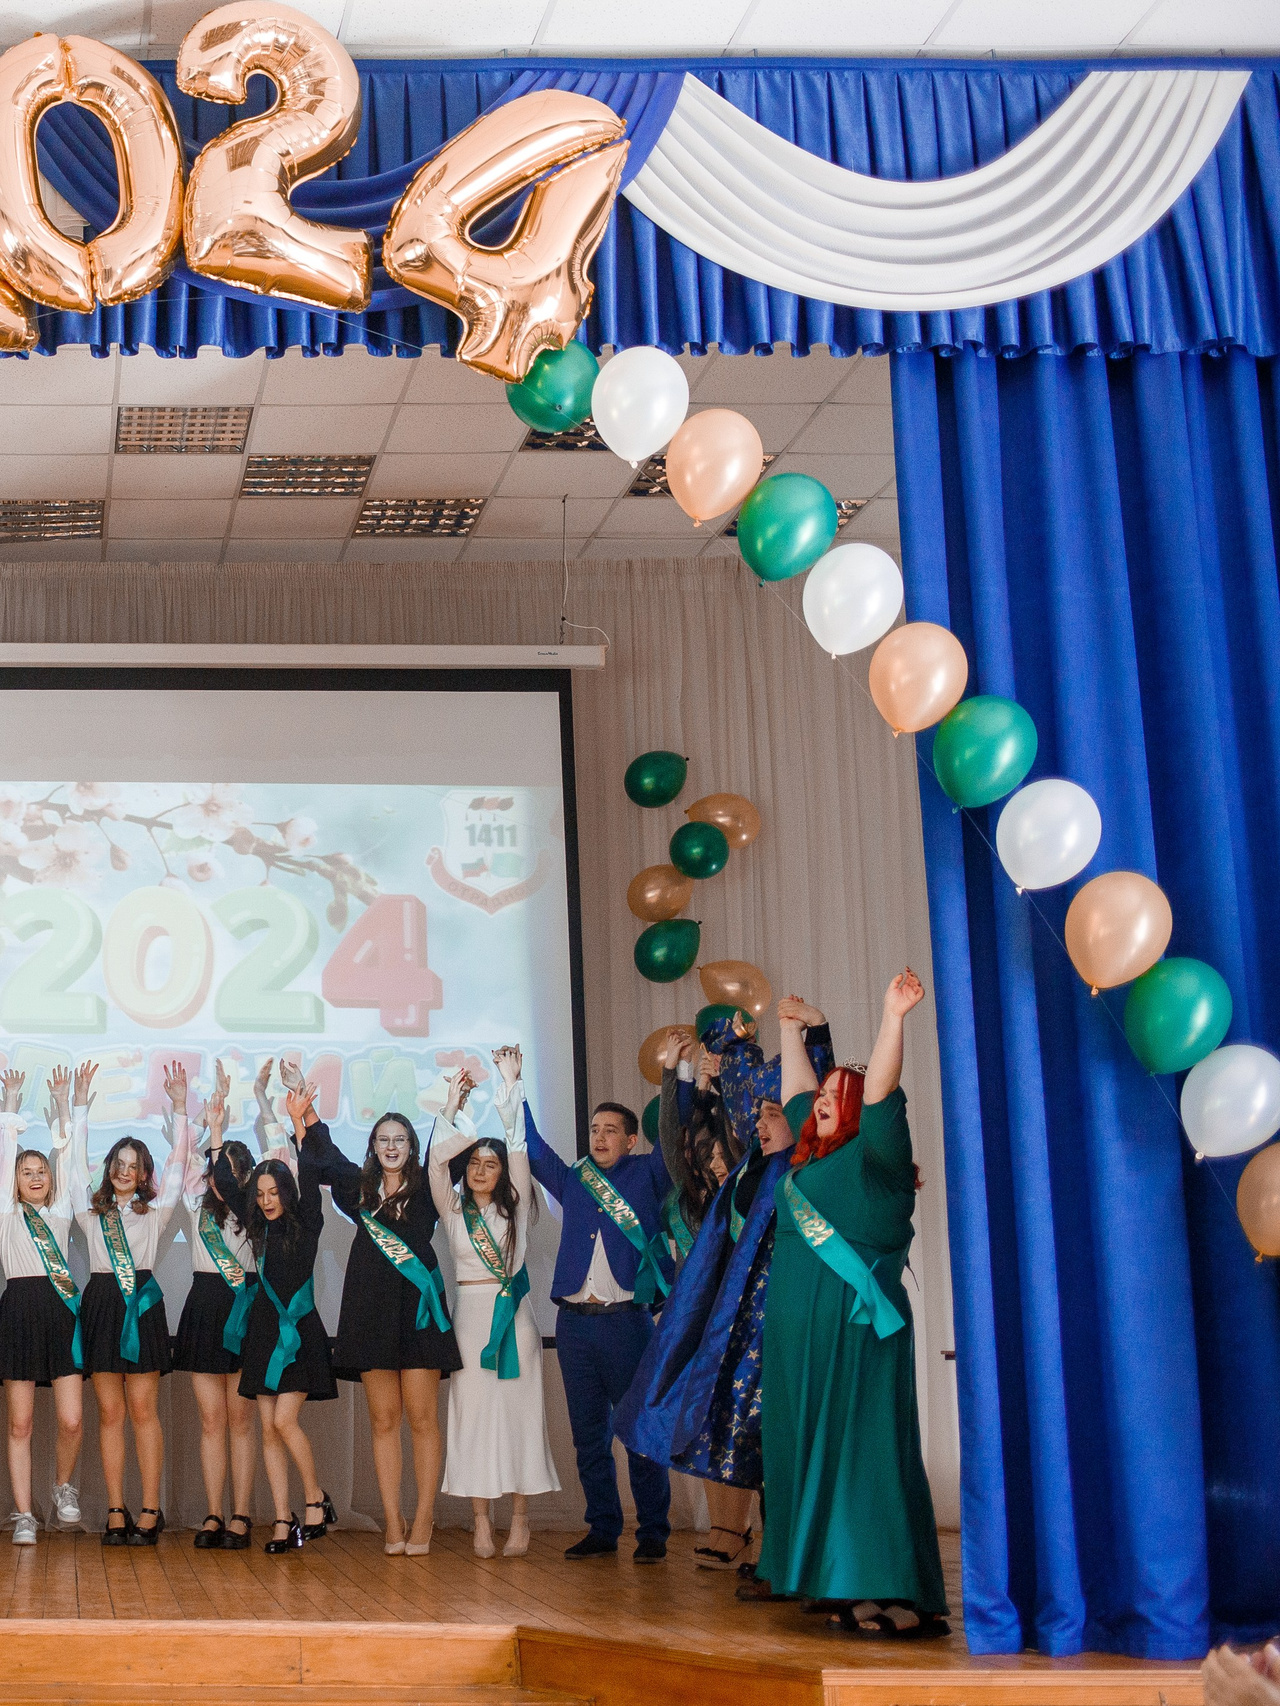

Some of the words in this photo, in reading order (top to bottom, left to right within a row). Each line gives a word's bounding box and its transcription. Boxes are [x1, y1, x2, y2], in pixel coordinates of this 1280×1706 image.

[464, 823, 519, 847] 1411
[793, 1202, 834, 1247] 2024
[376, 1234, 414, 1265] 2024
[216, 1256, 245, 1287] 2024
